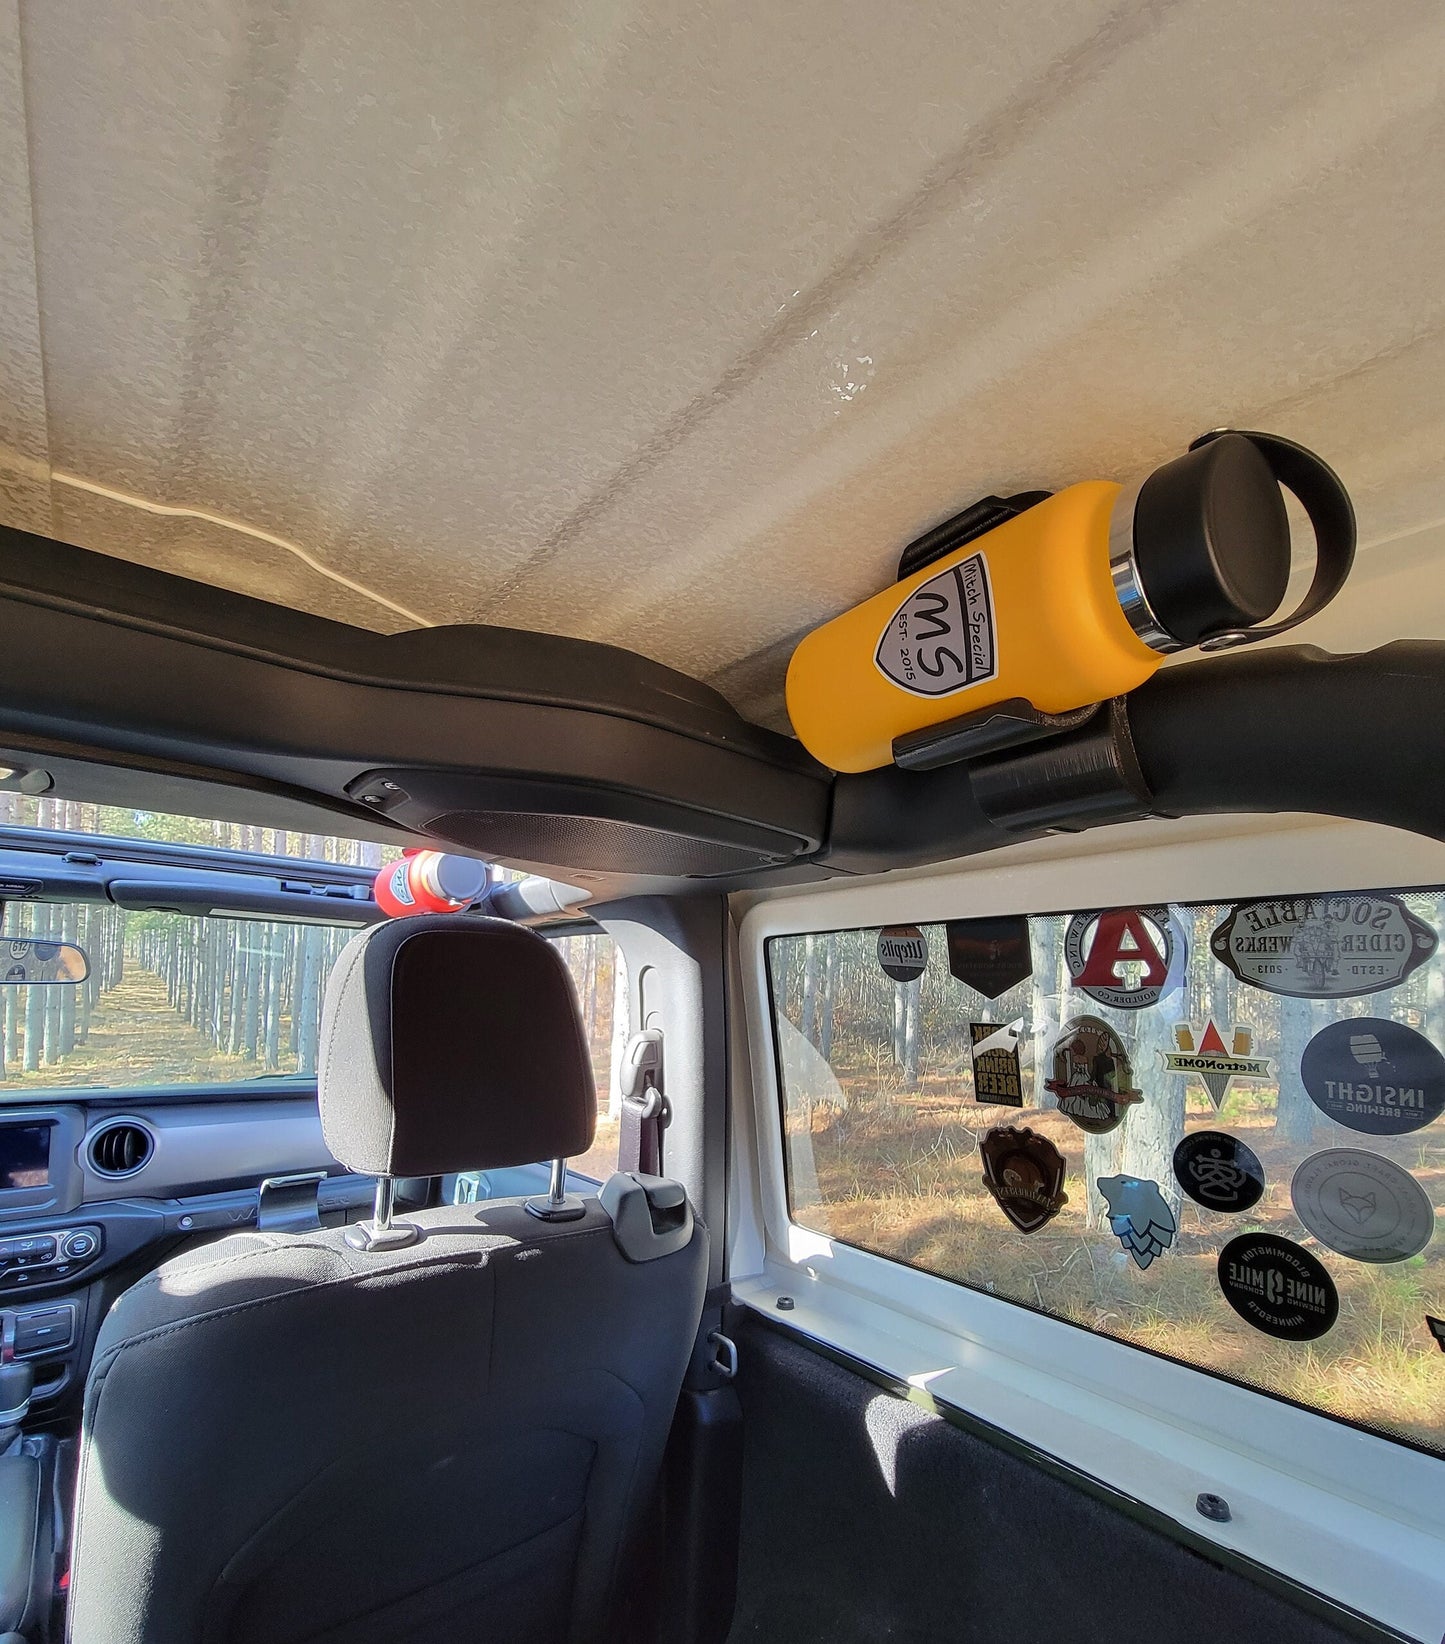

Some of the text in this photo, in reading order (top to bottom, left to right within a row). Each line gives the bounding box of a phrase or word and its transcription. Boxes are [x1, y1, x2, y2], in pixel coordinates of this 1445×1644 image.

[914, 591, 963, 677] MS
[963, 563, 989, 671] Mitch Special
[899, 648, 917, 680] 2015
